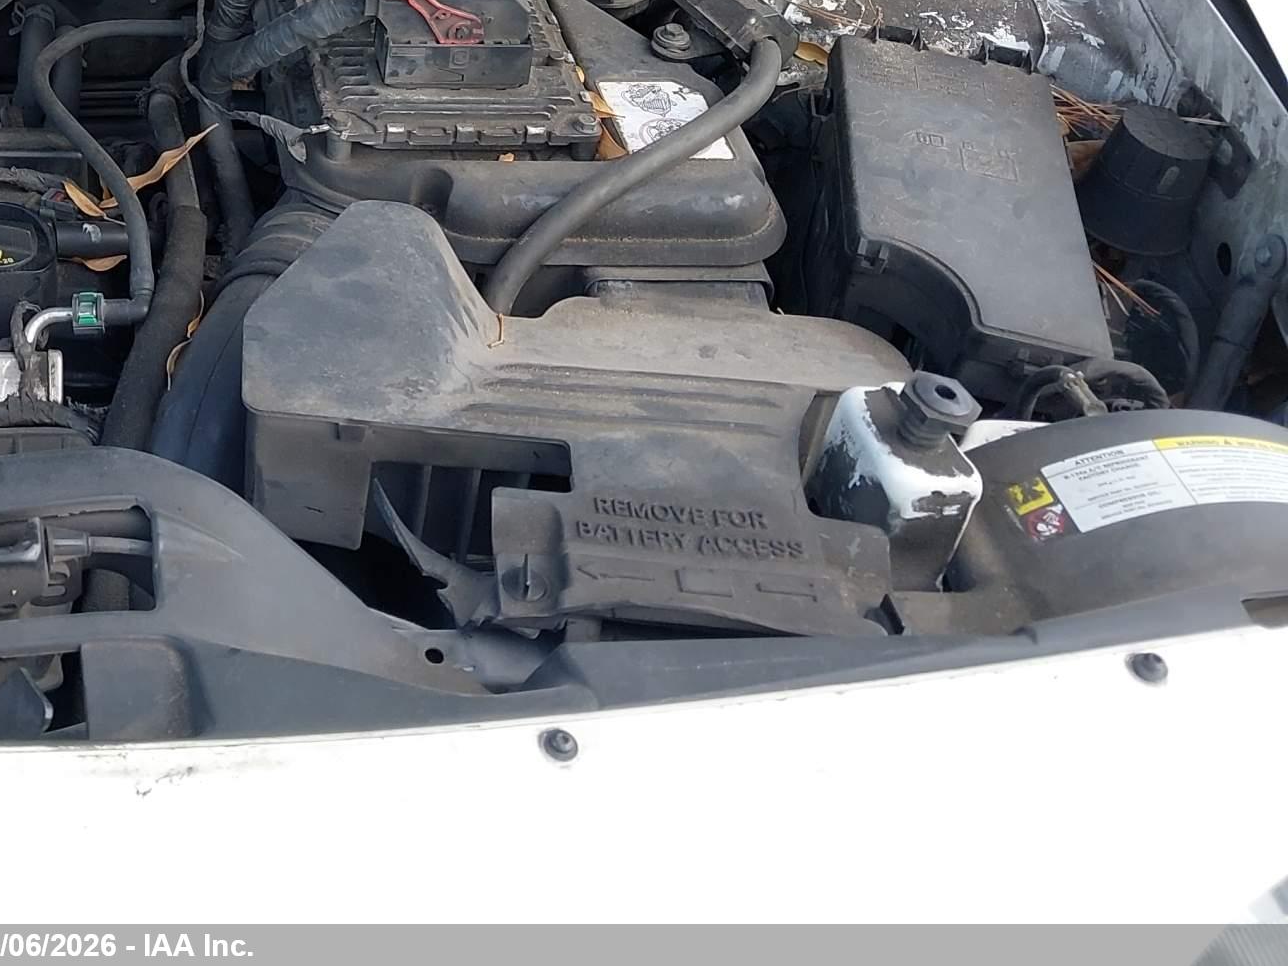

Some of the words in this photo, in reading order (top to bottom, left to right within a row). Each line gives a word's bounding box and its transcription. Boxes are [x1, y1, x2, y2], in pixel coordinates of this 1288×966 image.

[1074, 449, 1125, 466] ATTENTION
[593, 496, 705, 526] REMOVE
[712, 508, 768, 530] FOR
[576, 520, 686, 549] BATTERY
[697, 534, 804, 558] ACCESS
